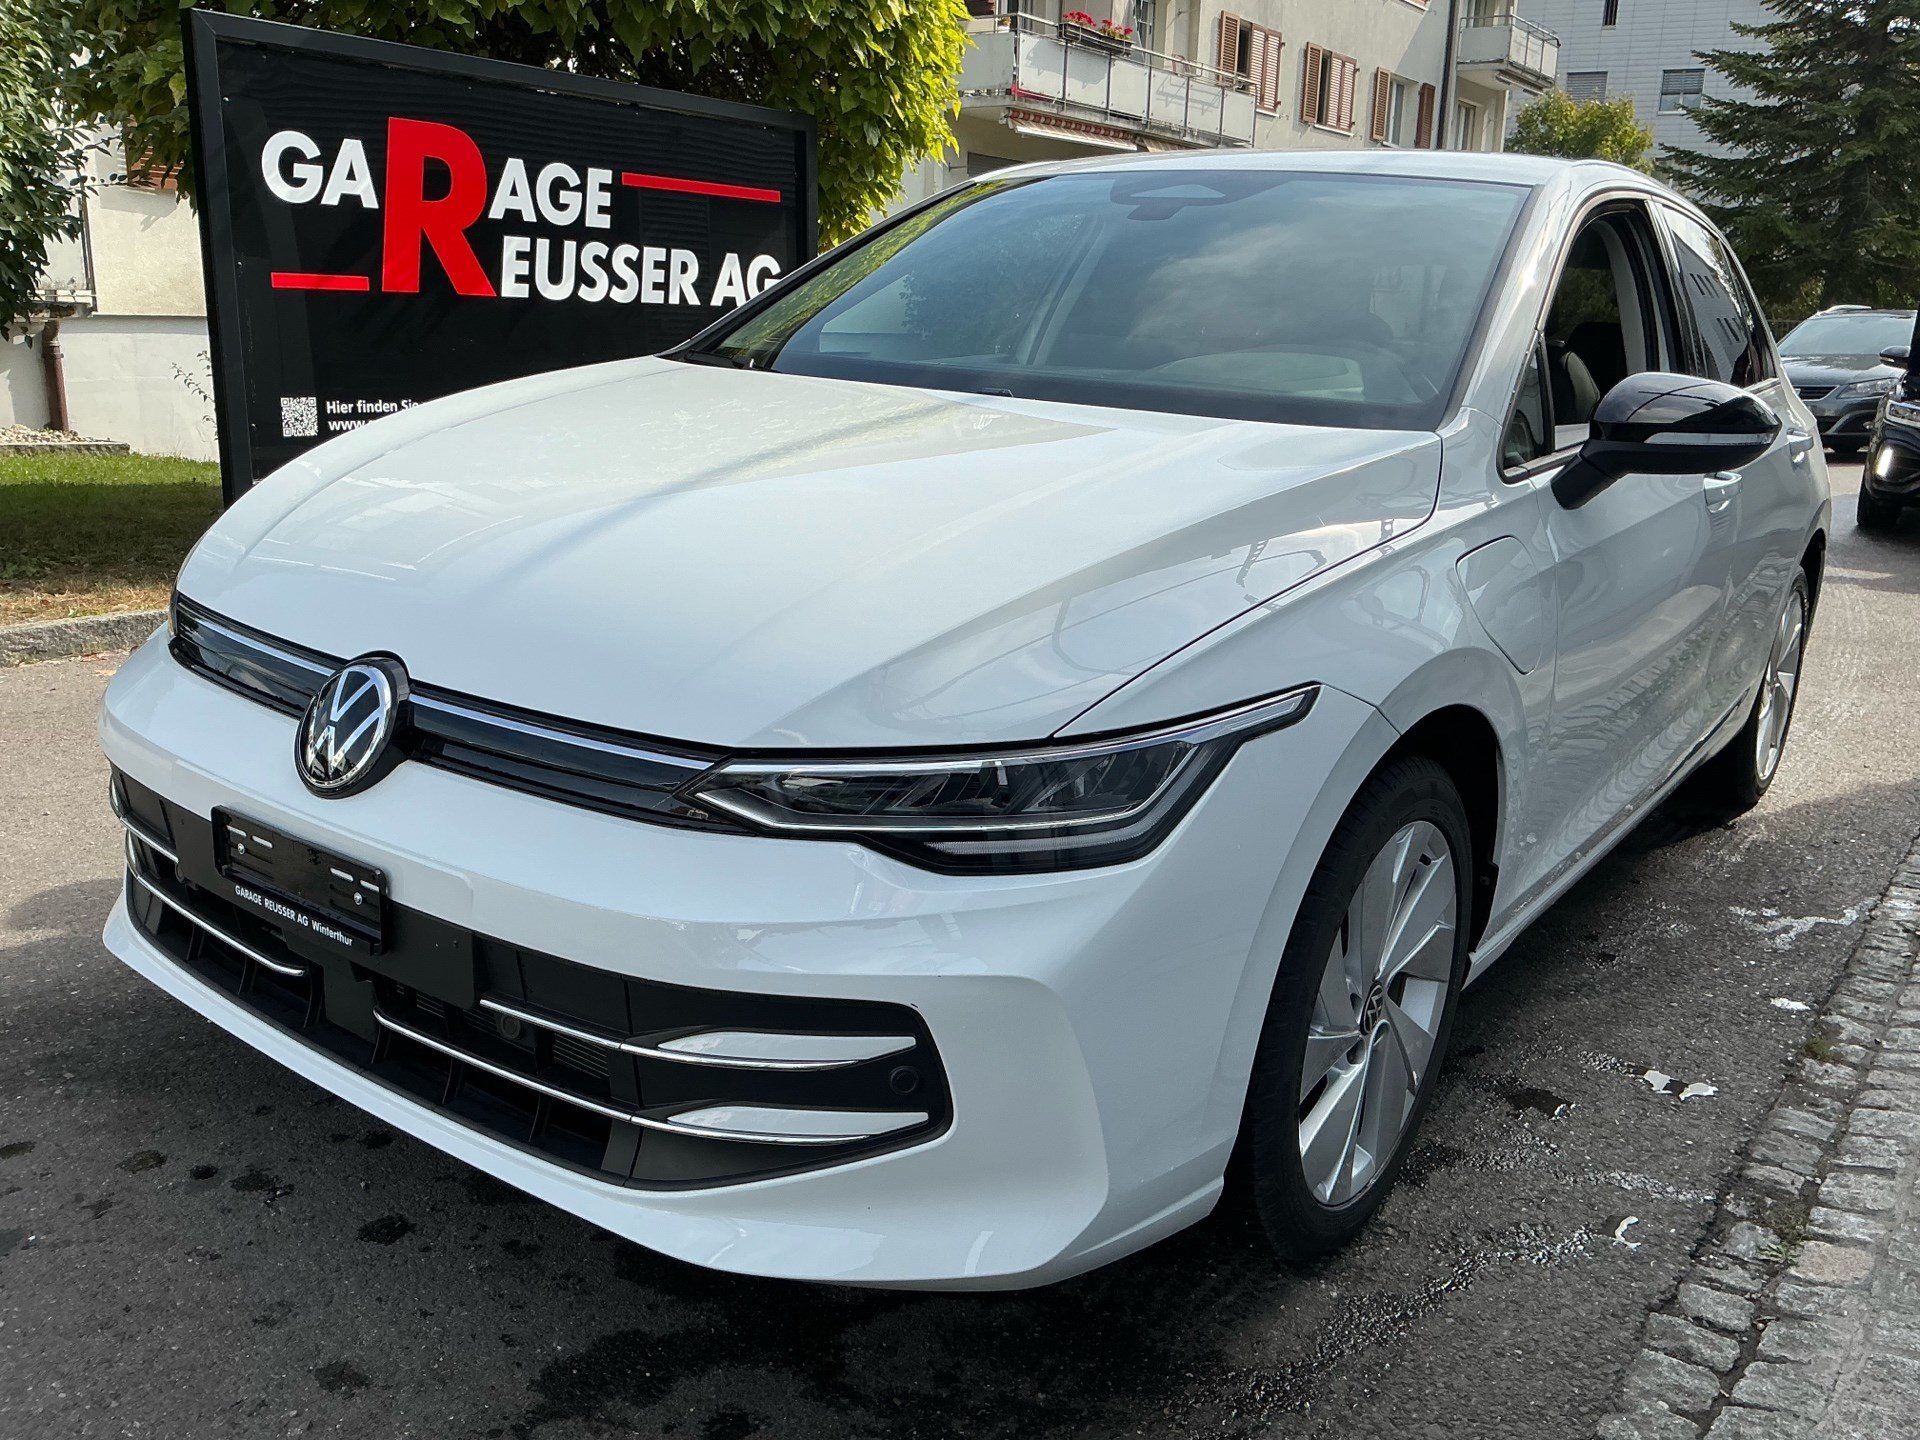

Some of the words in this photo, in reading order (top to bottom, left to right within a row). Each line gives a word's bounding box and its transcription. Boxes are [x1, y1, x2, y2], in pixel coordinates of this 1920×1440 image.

[709, 252, 782, 308] AG
[326, 401, 354, 414] Hier
[357, 399, 398, 413] finden
[235, 885, 262, 906] GARAGE
[264, 898, 296, 922] REUSSER
[297, 913, 309, 927] AG
[311, 920, 353, 947] Winterthur
